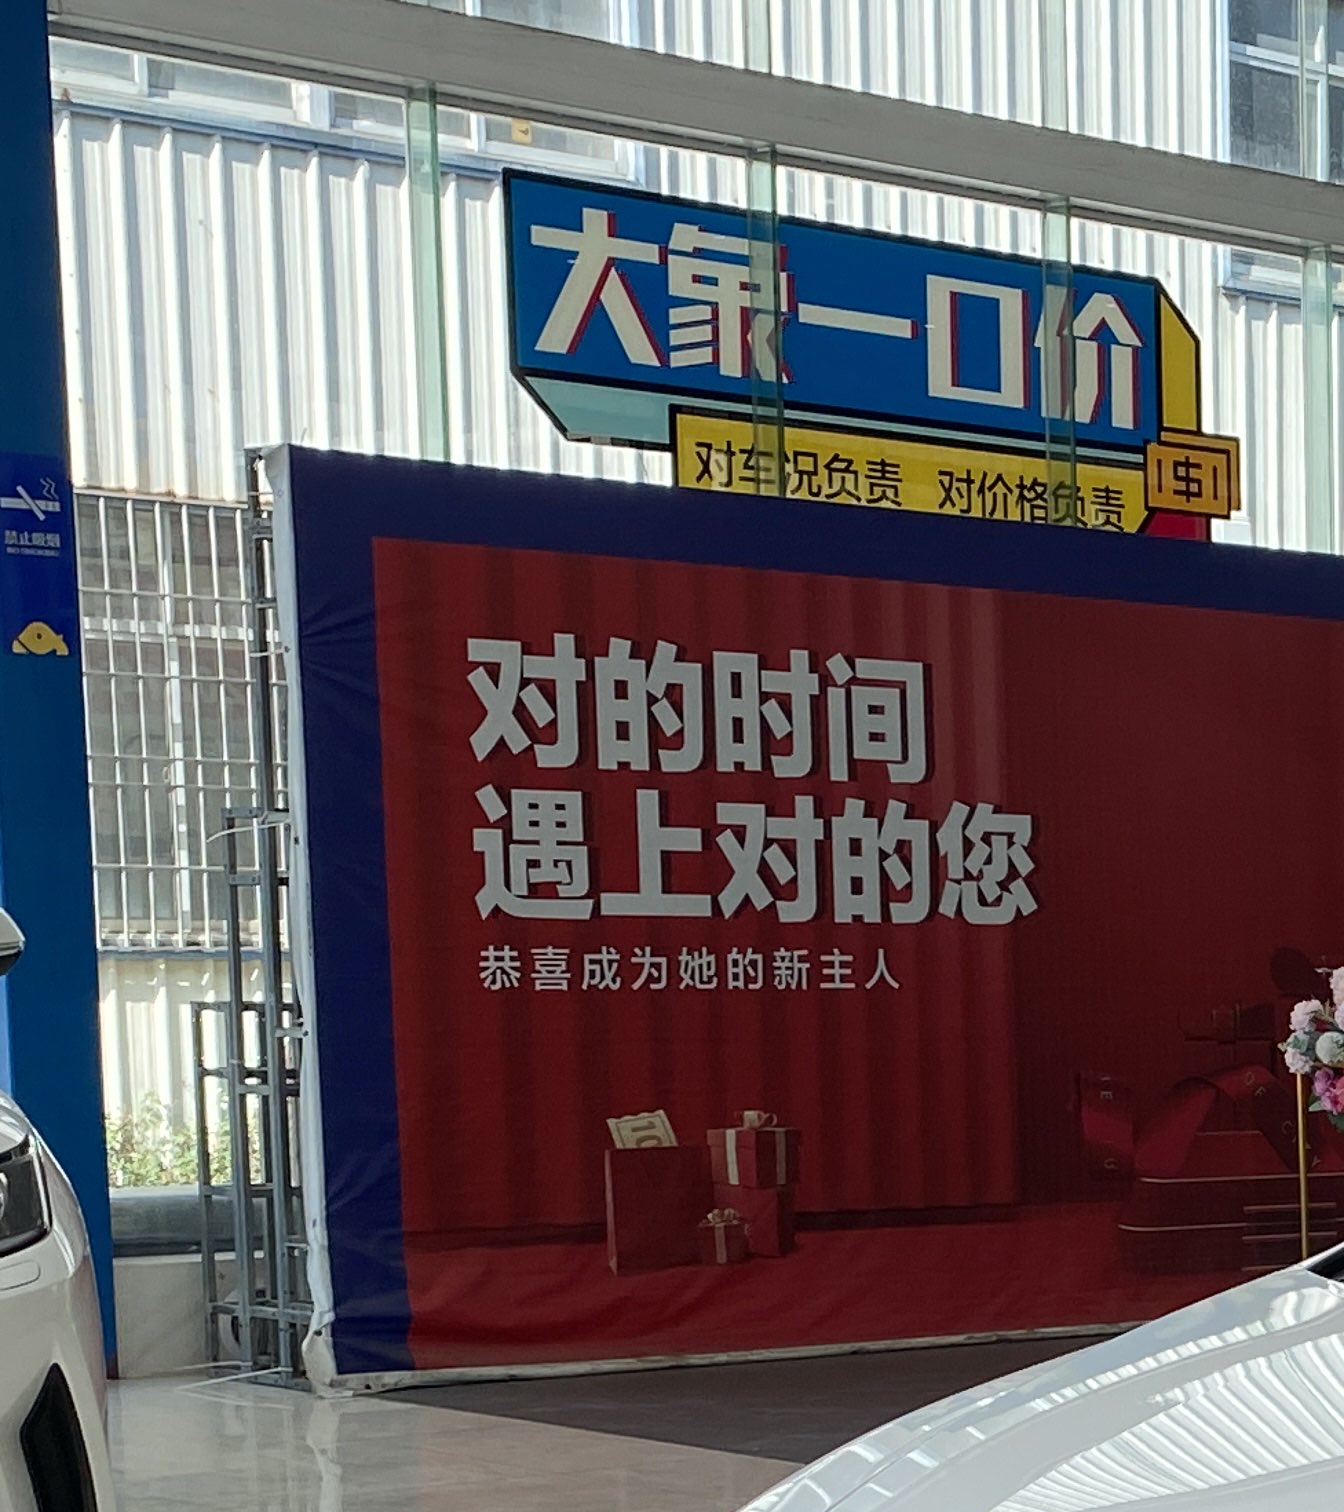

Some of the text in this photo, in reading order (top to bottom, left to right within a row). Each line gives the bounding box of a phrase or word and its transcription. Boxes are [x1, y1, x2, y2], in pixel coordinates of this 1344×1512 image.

[530, 207, 1144, 429] 大象一口价
[694, 440, 1127, 531] 对车况负责 对价格负责
[467, 633, 928, 784] 对的时间
[473, 783, 1038, 925] 遇上对的您
[479, 944, 901, 991] 恭喜成为她的新主人
